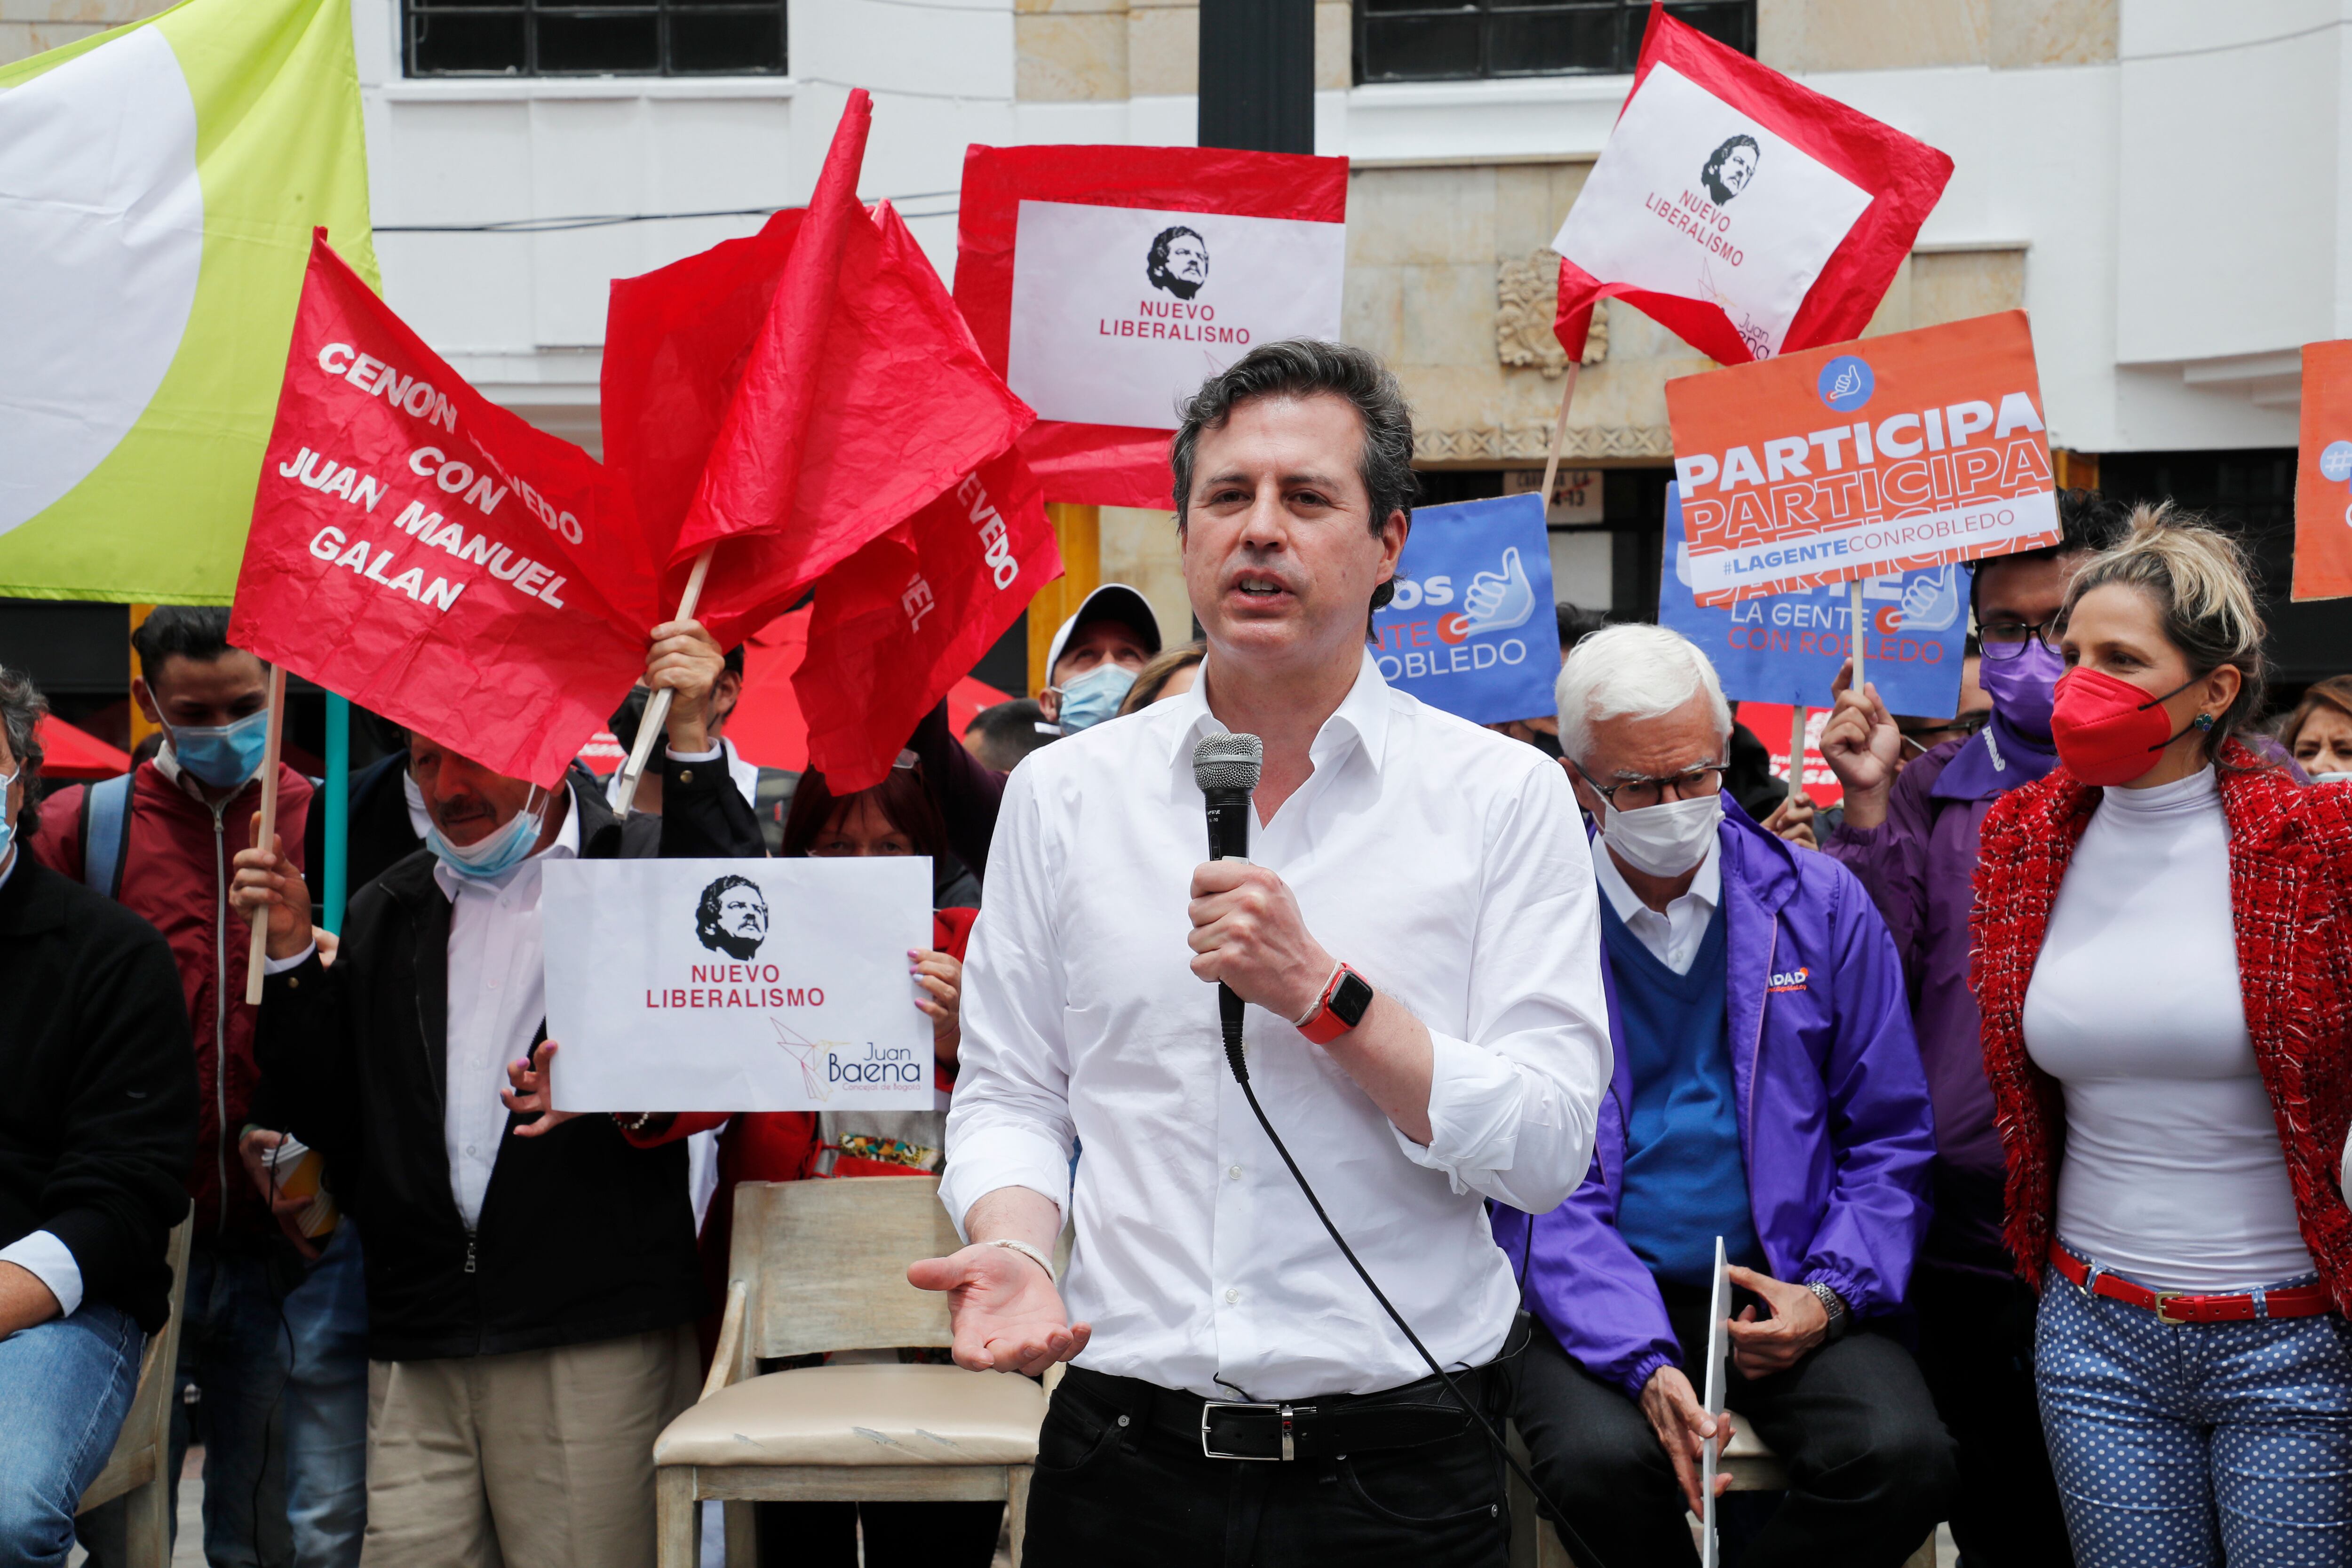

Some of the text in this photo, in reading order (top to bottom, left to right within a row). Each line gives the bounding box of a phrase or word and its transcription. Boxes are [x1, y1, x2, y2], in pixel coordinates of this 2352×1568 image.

[1645, 191, 1744, 267] LIBERALISMO
[1678, 189, 1730, 233] NUEVO
[1139, 300, 1215, 321] NUEVO
[1738, 312, 1770, 343] Juan
[1099, 318, 1251, 344] LIBERALISMO
[318, 342, 458, 434] CENON
[1675, 391, 2046, 500] PARTICIPA
[408, 446, 509, 515] CON
[1681, 438, 2052, 546] PARTICIPA
[279, 447, 569, 610] JUAN MANUEL
[1723, 509, 2014, 575] #LAGENTECONROBLEDO
[309, 525, 465, 613] GALAN
[1730, 601, 1764, 624] LA
[1728, 626, 1790, 653] CON
[1376, 638, 1526, 682] OBLEDO
[691, 964, 780, 983] NUEVO
[646, 987, 825, 1008] LIBERALISMO
[829, 1053, 920, 1082] Baena
[863, 1042, 911, 1061] Juan
[842, 1082, 878, 1091] Concejal
